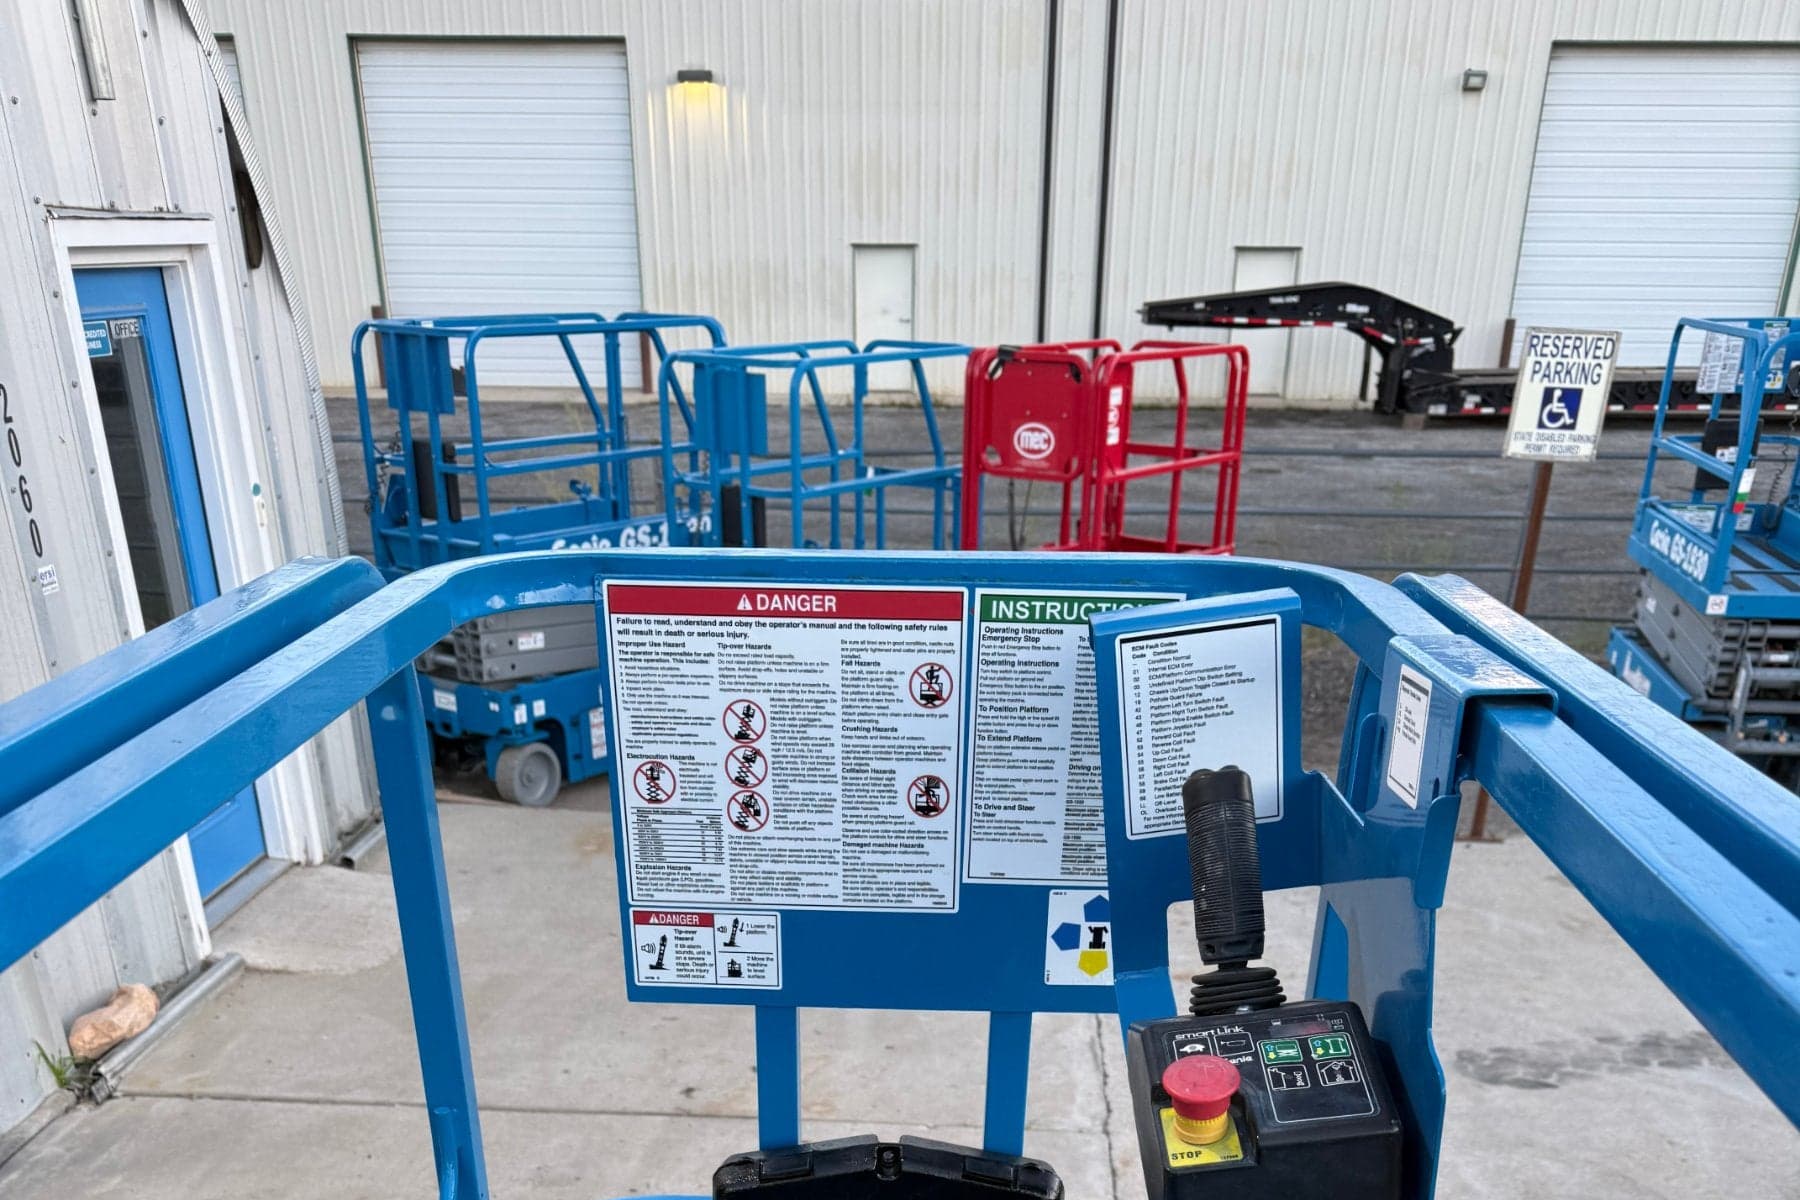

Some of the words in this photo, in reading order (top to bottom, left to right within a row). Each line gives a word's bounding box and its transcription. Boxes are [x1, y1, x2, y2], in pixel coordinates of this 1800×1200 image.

[114, 321, 139, 337] OFFICE
[1528, 334, 1616, 360] RESERVED
[1530, 360, 1603, 385] PARKING
[756, 593, 837, 613] DANGER
[617, 617, 642, 625] Failure
[675, 619, 716, 627] understand
[735, 620, 752, 628] obey
[769, 621, 807, 630] operator's
[868, 623, 902, 632] following
[904, 624, 926, 632] safety
[726, 631, 750, 639] injury.
[985, 626, 1019, 635] Operating
[1021, 626, 1064, 635] Instructions
[982, 635, 1021, 643] Emergency
[1024, 635, 1040, 643] Stop
[618, 640, 647, 648] Improper
[717, 642, 743, 650] Tip-over
[981, 658, 1016, 667] Operating
[1017, 659, 1059, 667] Instructions
[842, 725, 871, 733] Crushing
[1069, 764, 1091, 772] Driving
[659, 913, 700, 925] DANGER
[1171, 1150, 1203, 1161] STOP
